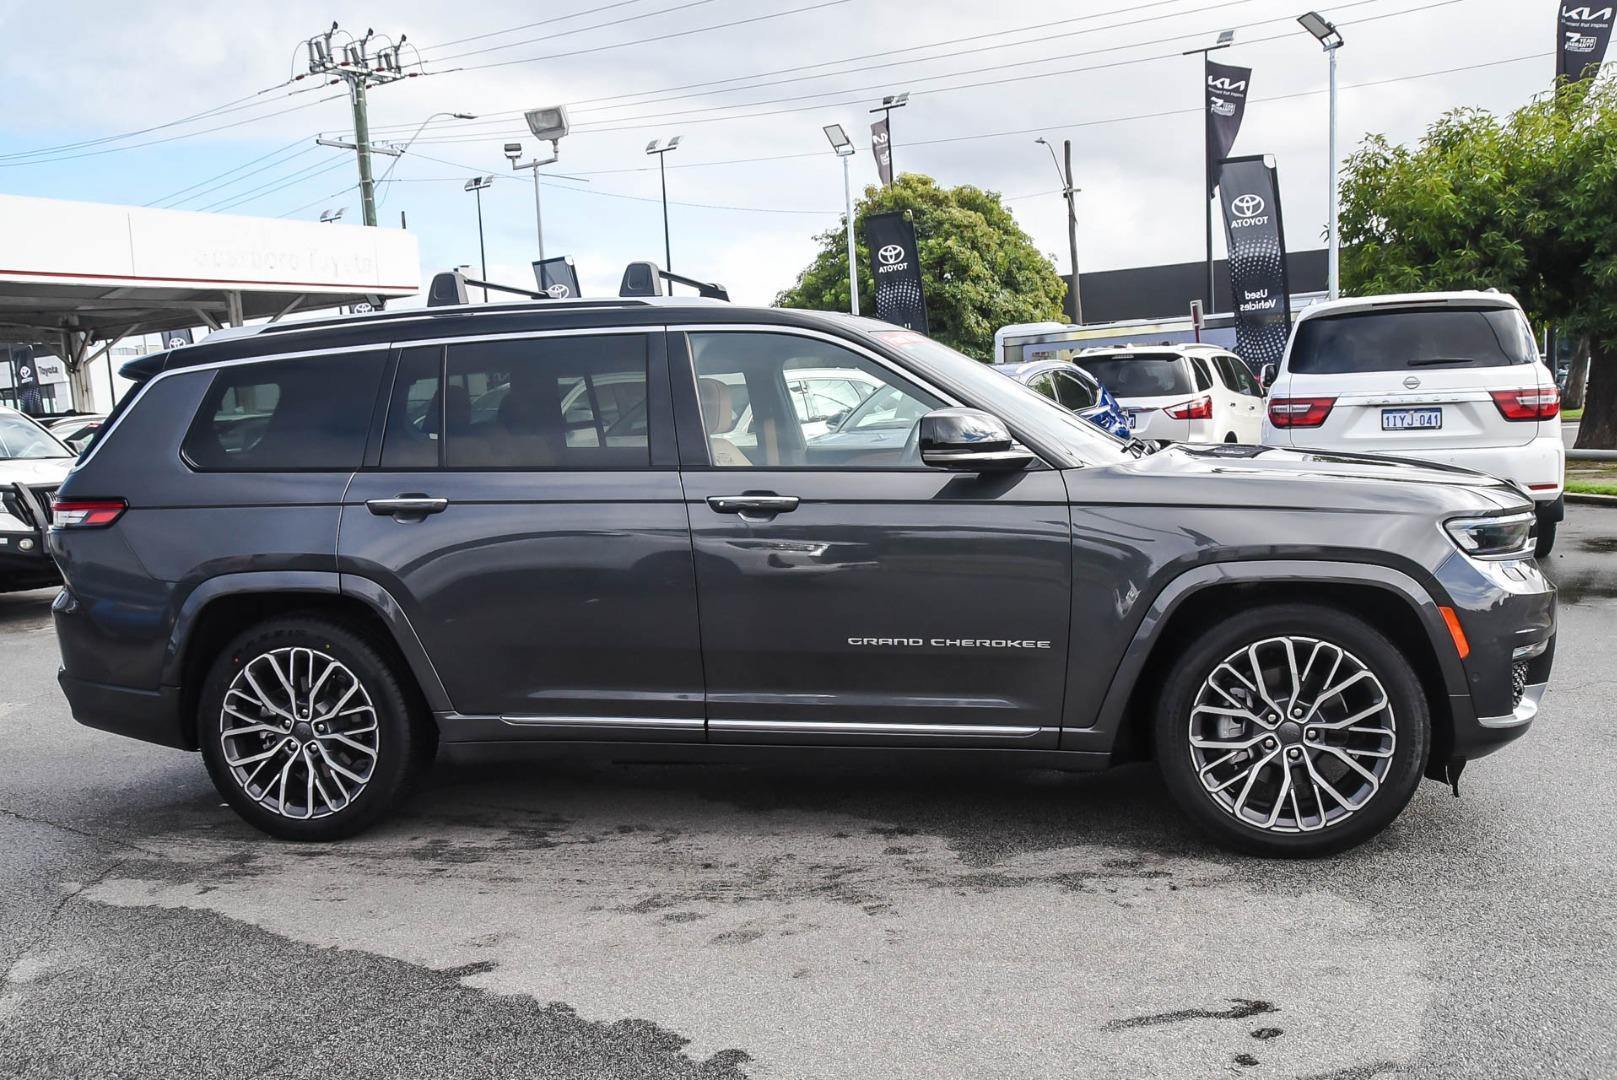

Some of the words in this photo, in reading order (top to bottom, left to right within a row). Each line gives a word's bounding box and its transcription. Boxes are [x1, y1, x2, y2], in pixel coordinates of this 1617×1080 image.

[1562, 5, 1612, 20] KIA
[1208, 75, 1245, 91] KIA
[847, 637, 923, 646] GRAND
[930, 638, 1051, 649] CHEROKEE
